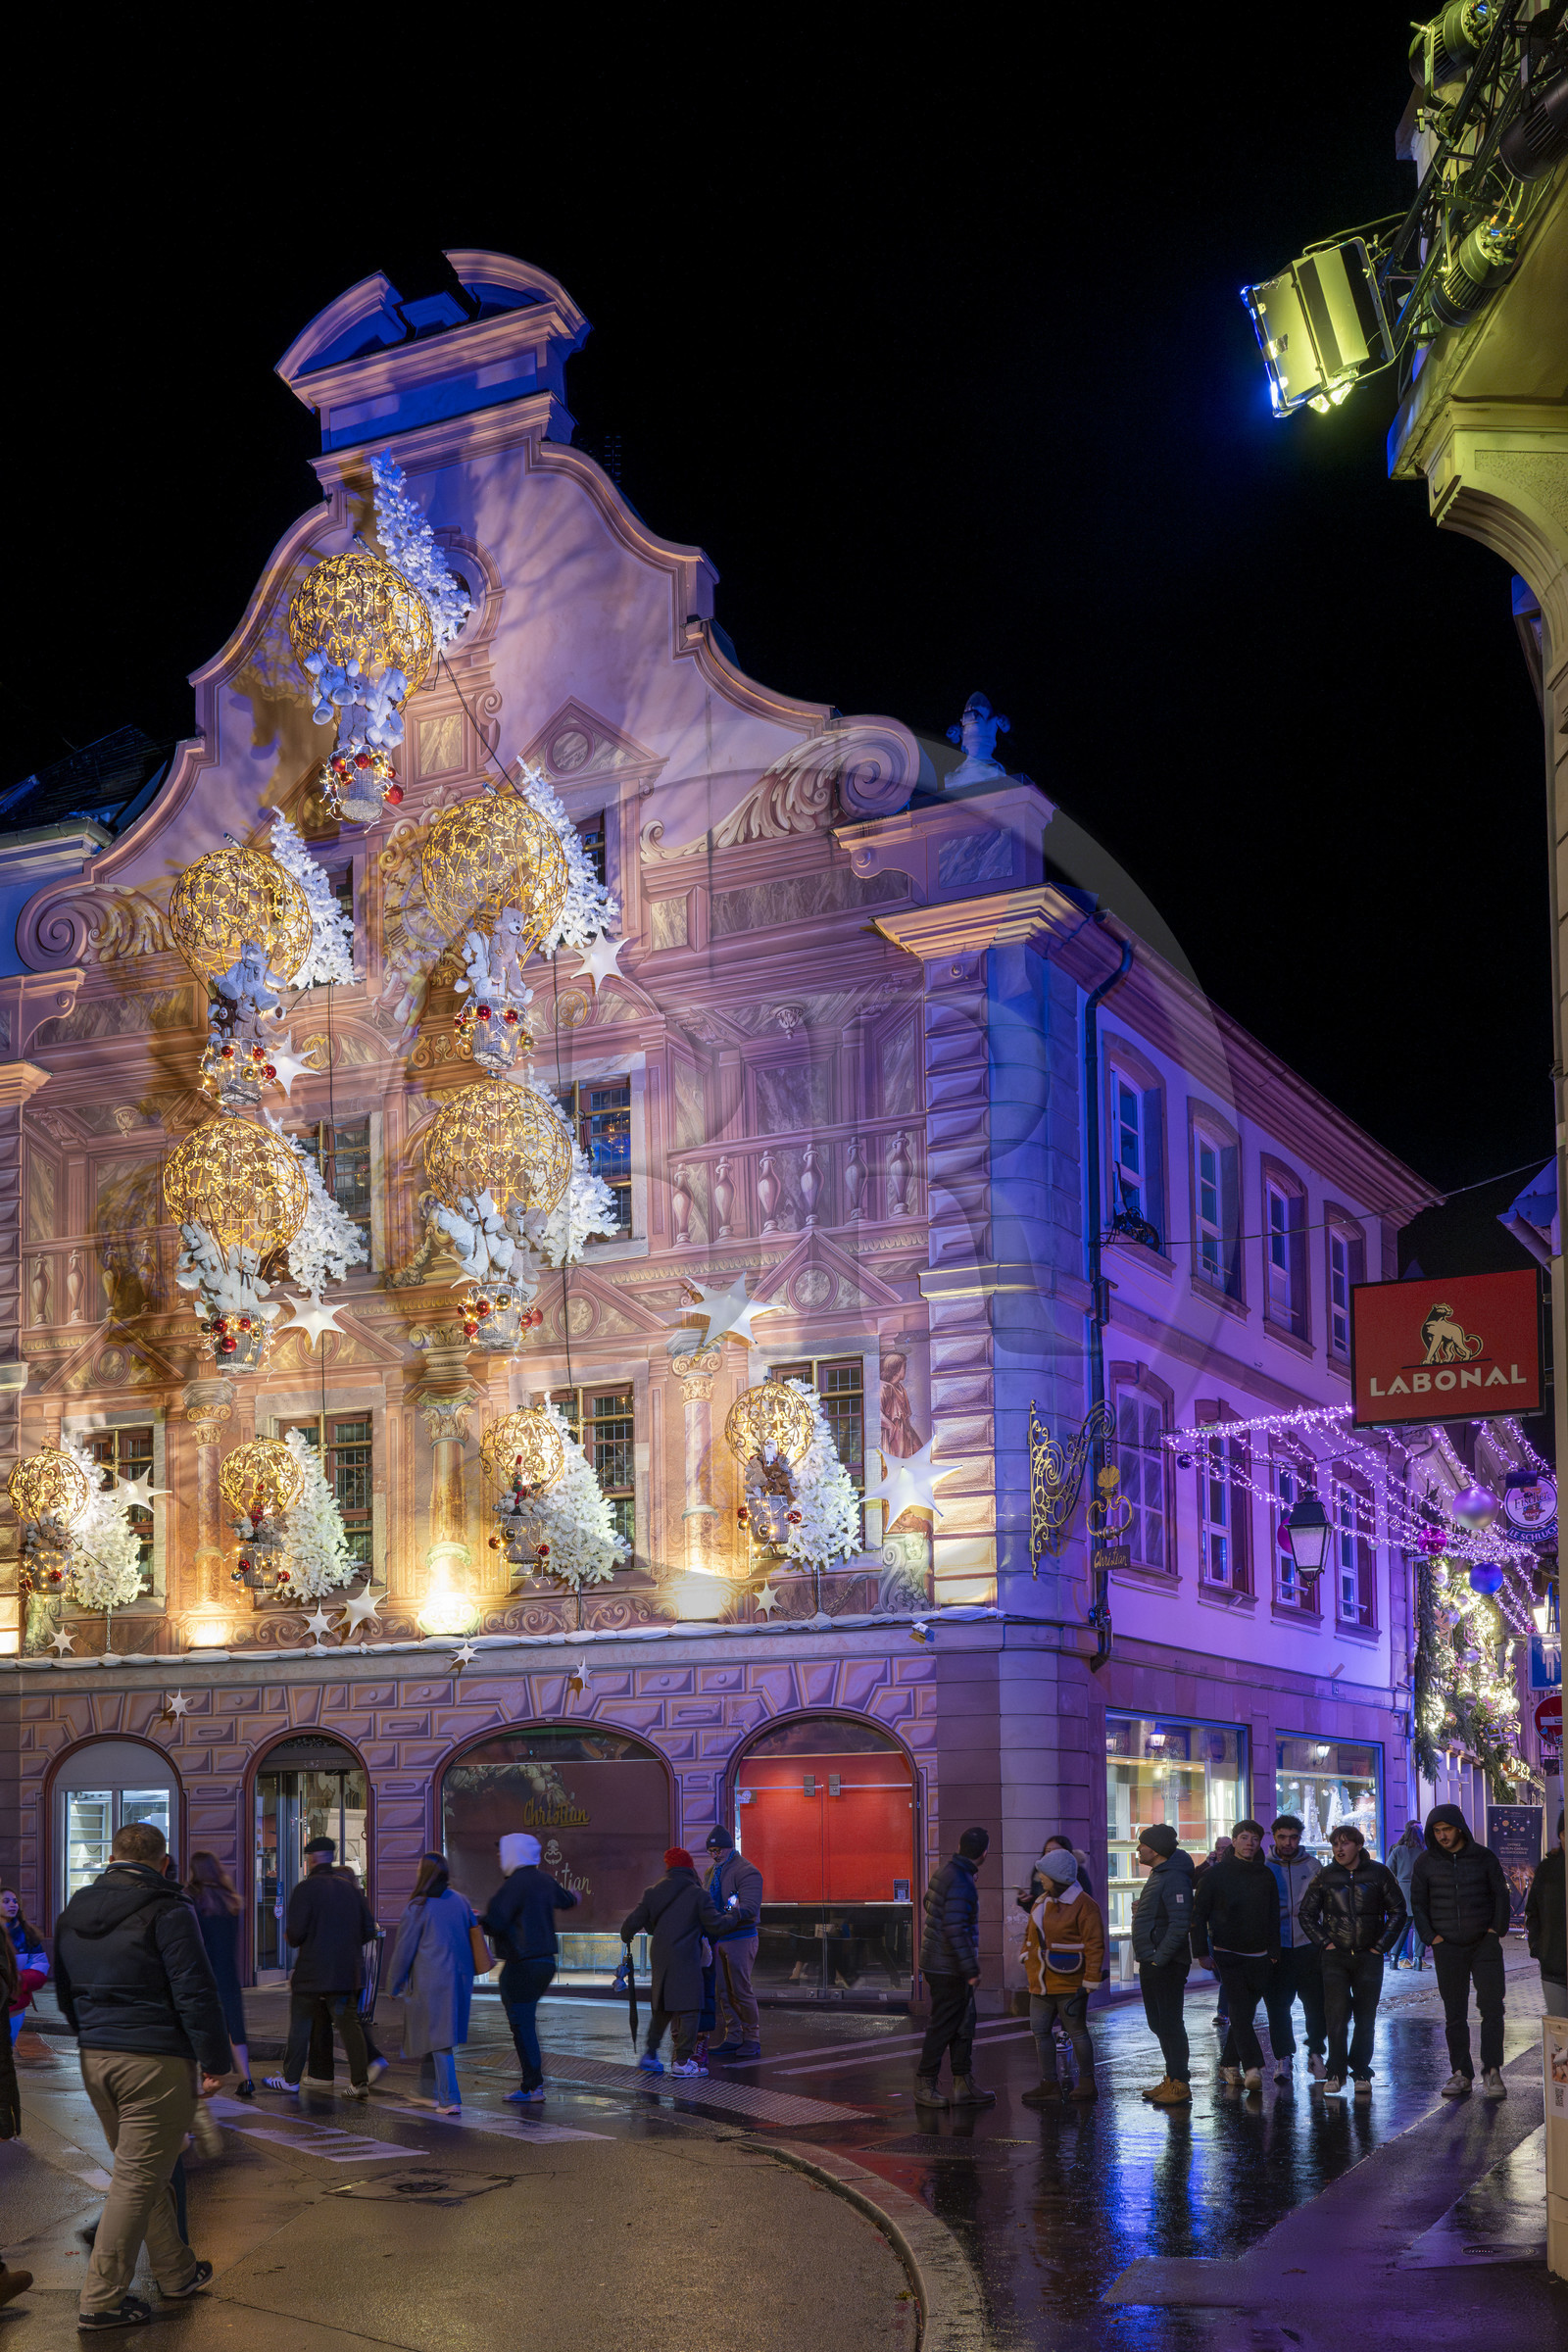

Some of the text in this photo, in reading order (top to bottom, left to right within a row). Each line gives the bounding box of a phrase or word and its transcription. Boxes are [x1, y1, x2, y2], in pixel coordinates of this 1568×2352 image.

[1370, 1364, 1527, 1397] LABONAL
[1514, 1490, 1548, 1510] Fischer
[1509, 1529, 1519, 1539] LE
[1094, 1546, 1128, 1569] Christian
[523, 1795, 592, 1827] Christian
